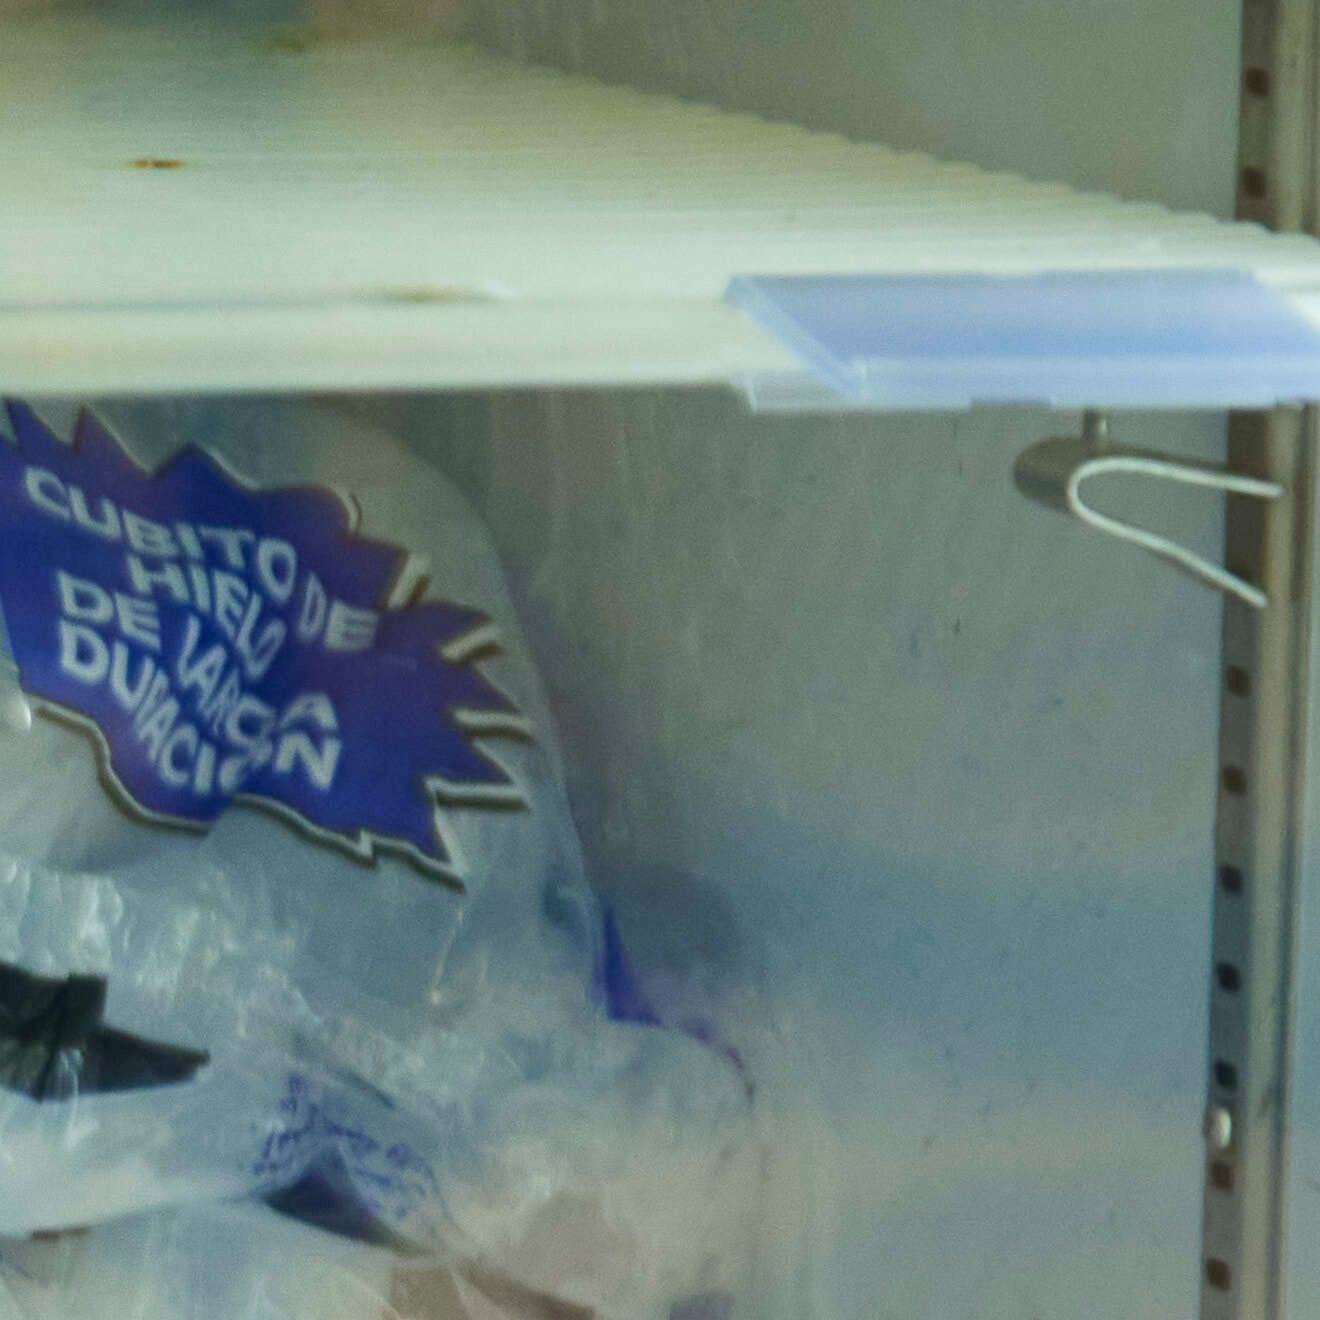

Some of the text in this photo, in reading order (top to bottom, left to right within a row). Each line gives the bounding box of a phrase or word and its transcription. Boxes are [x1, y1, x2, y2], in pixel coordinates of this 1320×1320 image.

[23, 466, 379, 653] CUBITO DE
[56, 569, 163, 651] DE
